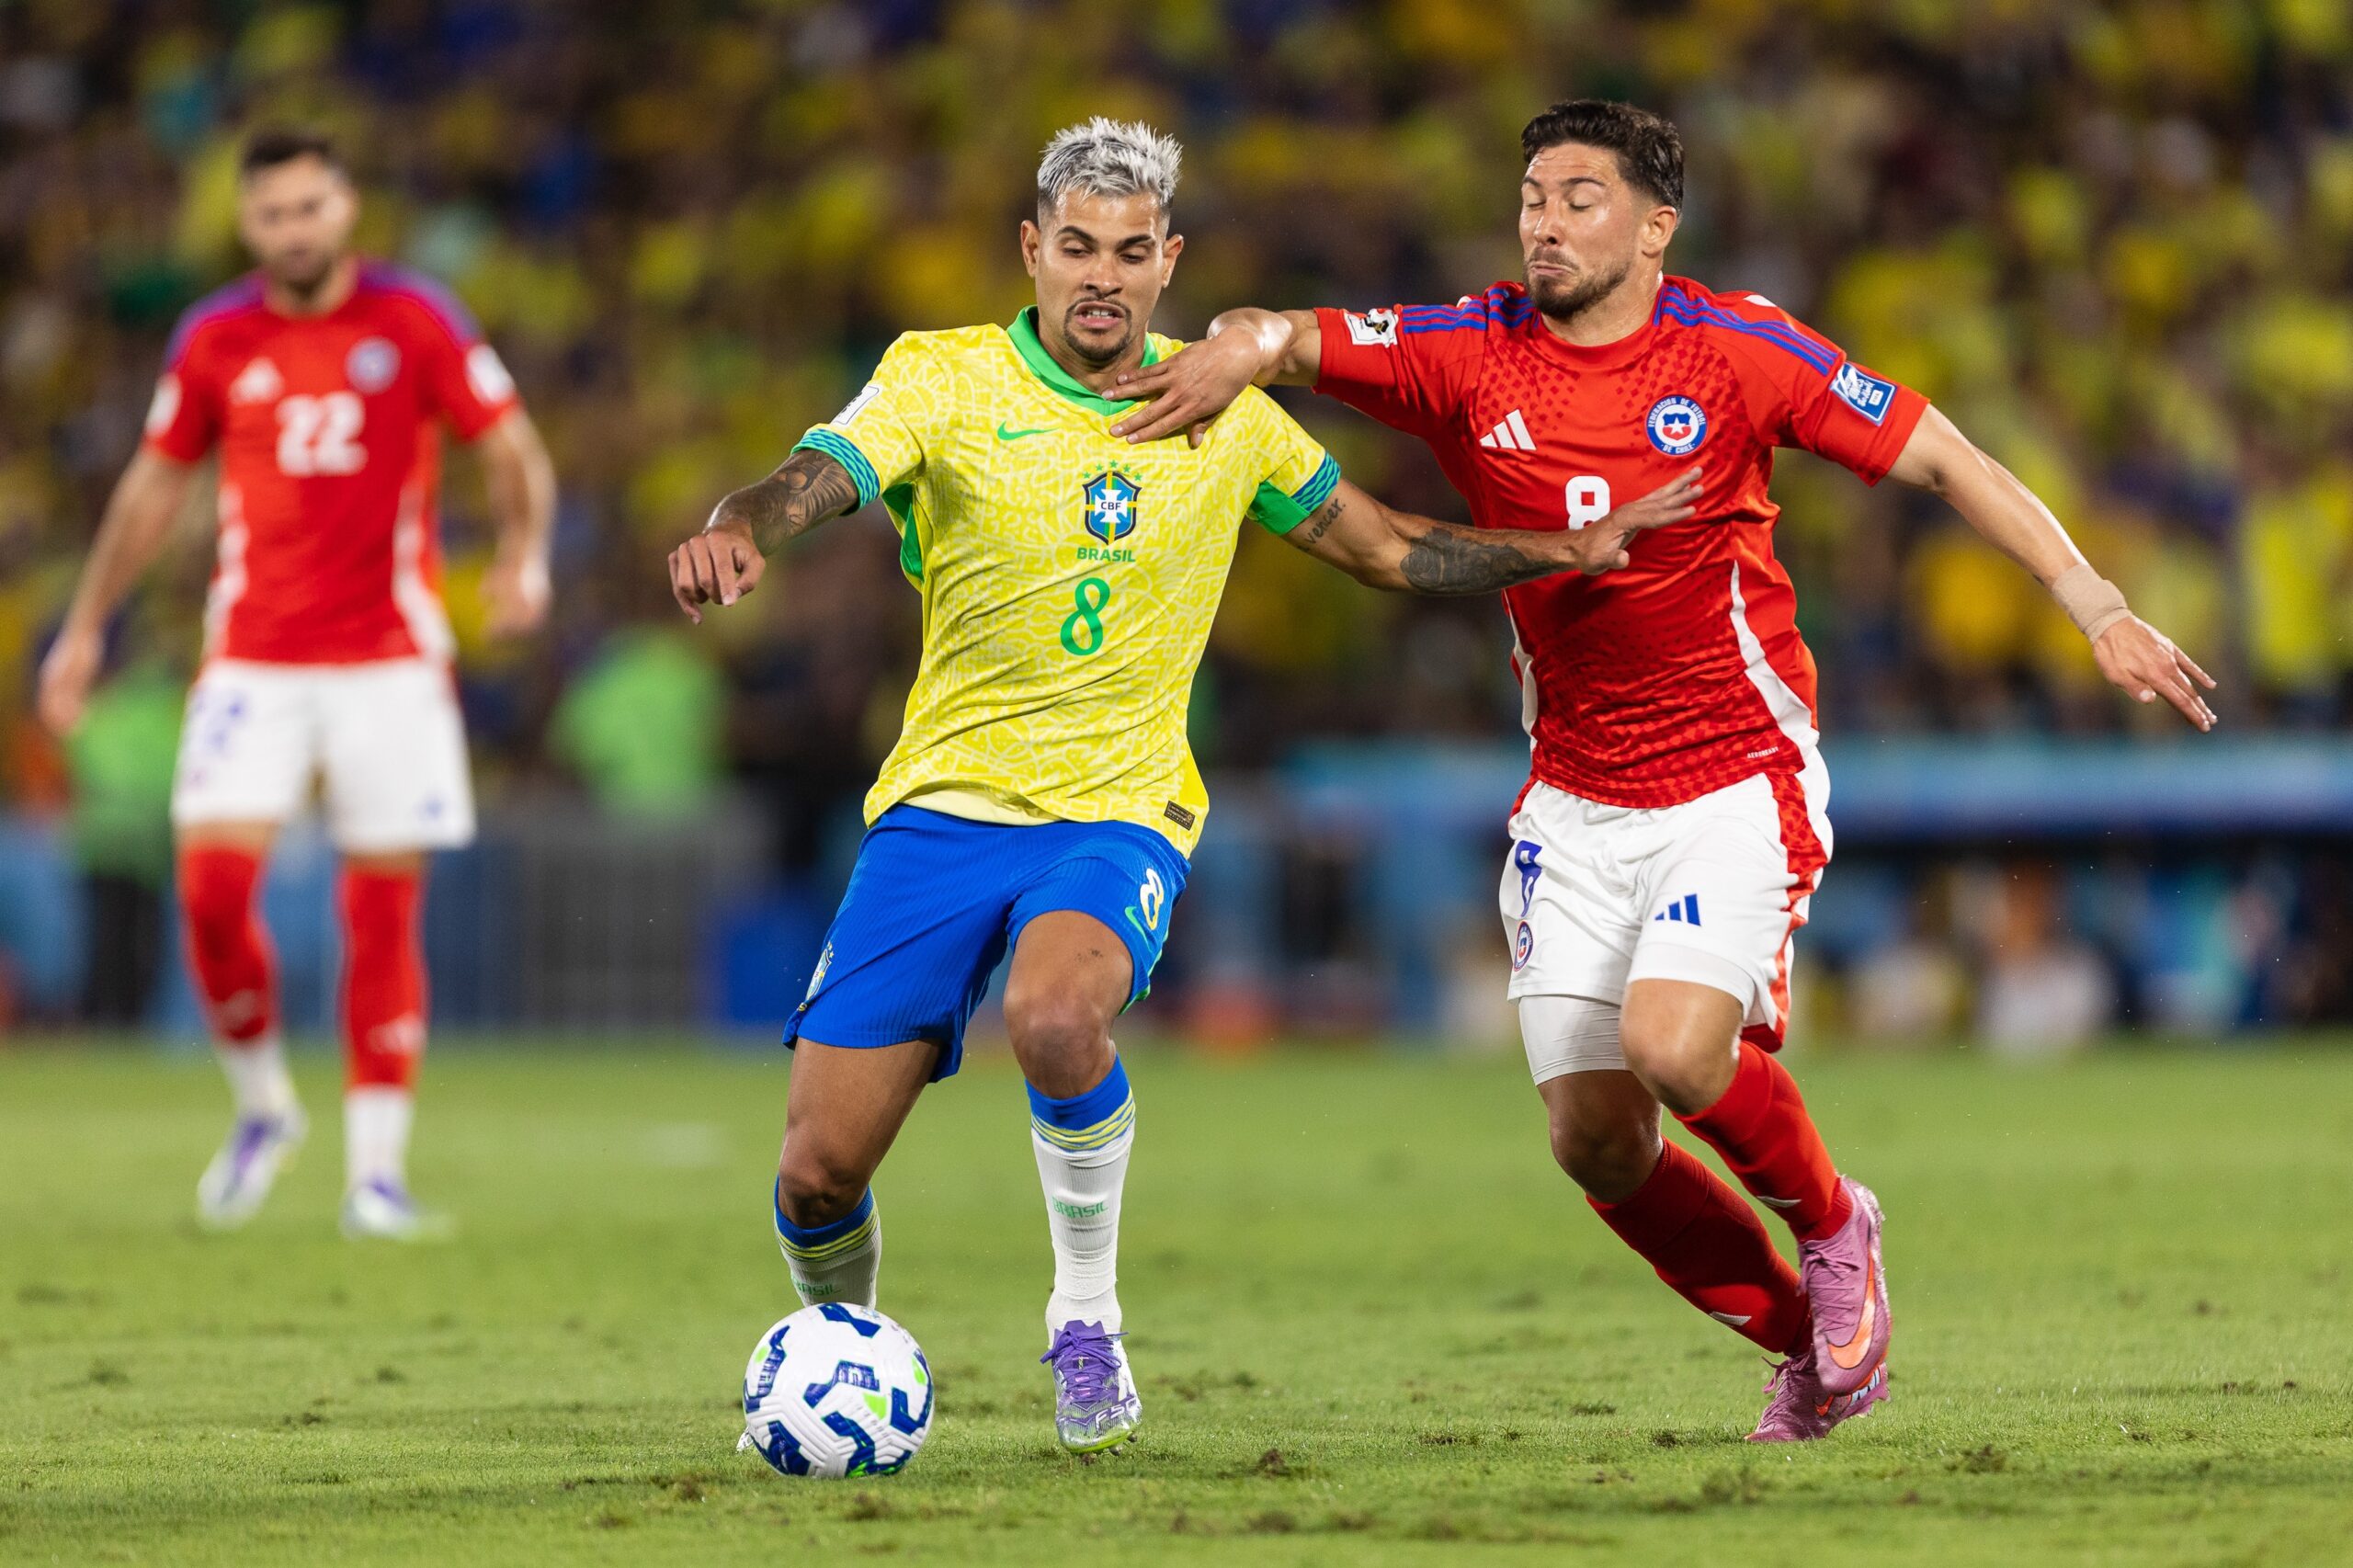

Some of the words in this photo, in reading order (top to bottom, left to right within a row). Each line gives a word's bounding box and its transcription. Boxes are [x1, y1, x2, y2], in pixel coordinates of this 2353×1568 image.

[275, 391, 369, 477] 22
[1100, 502, 1121, 511] CBF
[1565, 475, 1610, 530] 8
[1076, 547, 1136, 562] BRASIL
[1060, 578, 1110, 656] 8
[1140, 868, 1165, 930] 8
[1051, 1195, 1108, 1219] BRASIL
